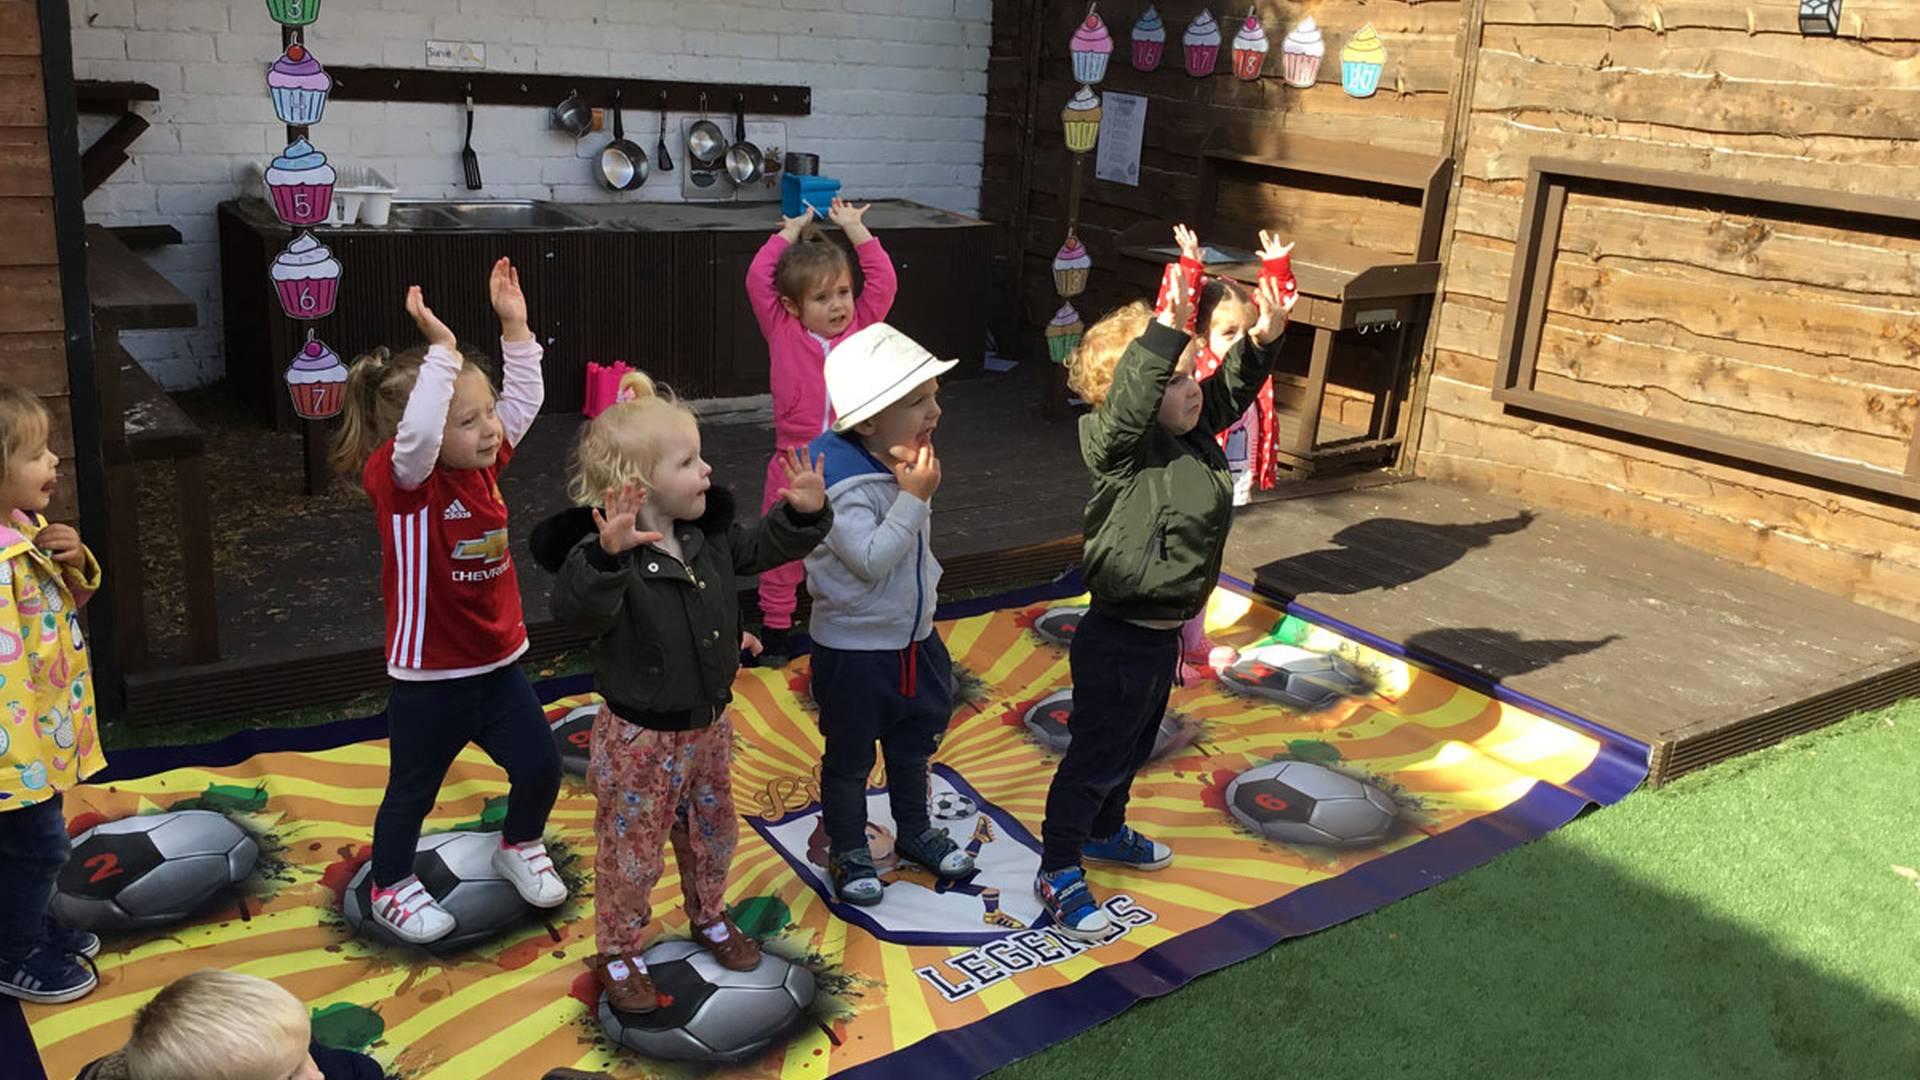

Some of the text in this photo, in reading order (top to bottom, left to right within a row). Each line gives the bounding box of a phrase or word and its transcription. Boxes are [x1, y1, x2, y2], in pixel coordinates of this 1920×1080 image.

[287, 0, 303, 18] 3
[1138, 47, 1154, 65] 16
[1192, 50, 1209, 70] 17
[1238, 55, 1257, 75] 18
[294, 193, 312, 217] 5
[300, 287, 316, 311] 6
[312, 388, 326, 412] 7
[1255, 793, 1289, 811] 6
[83, 852, 124, 884] 2
